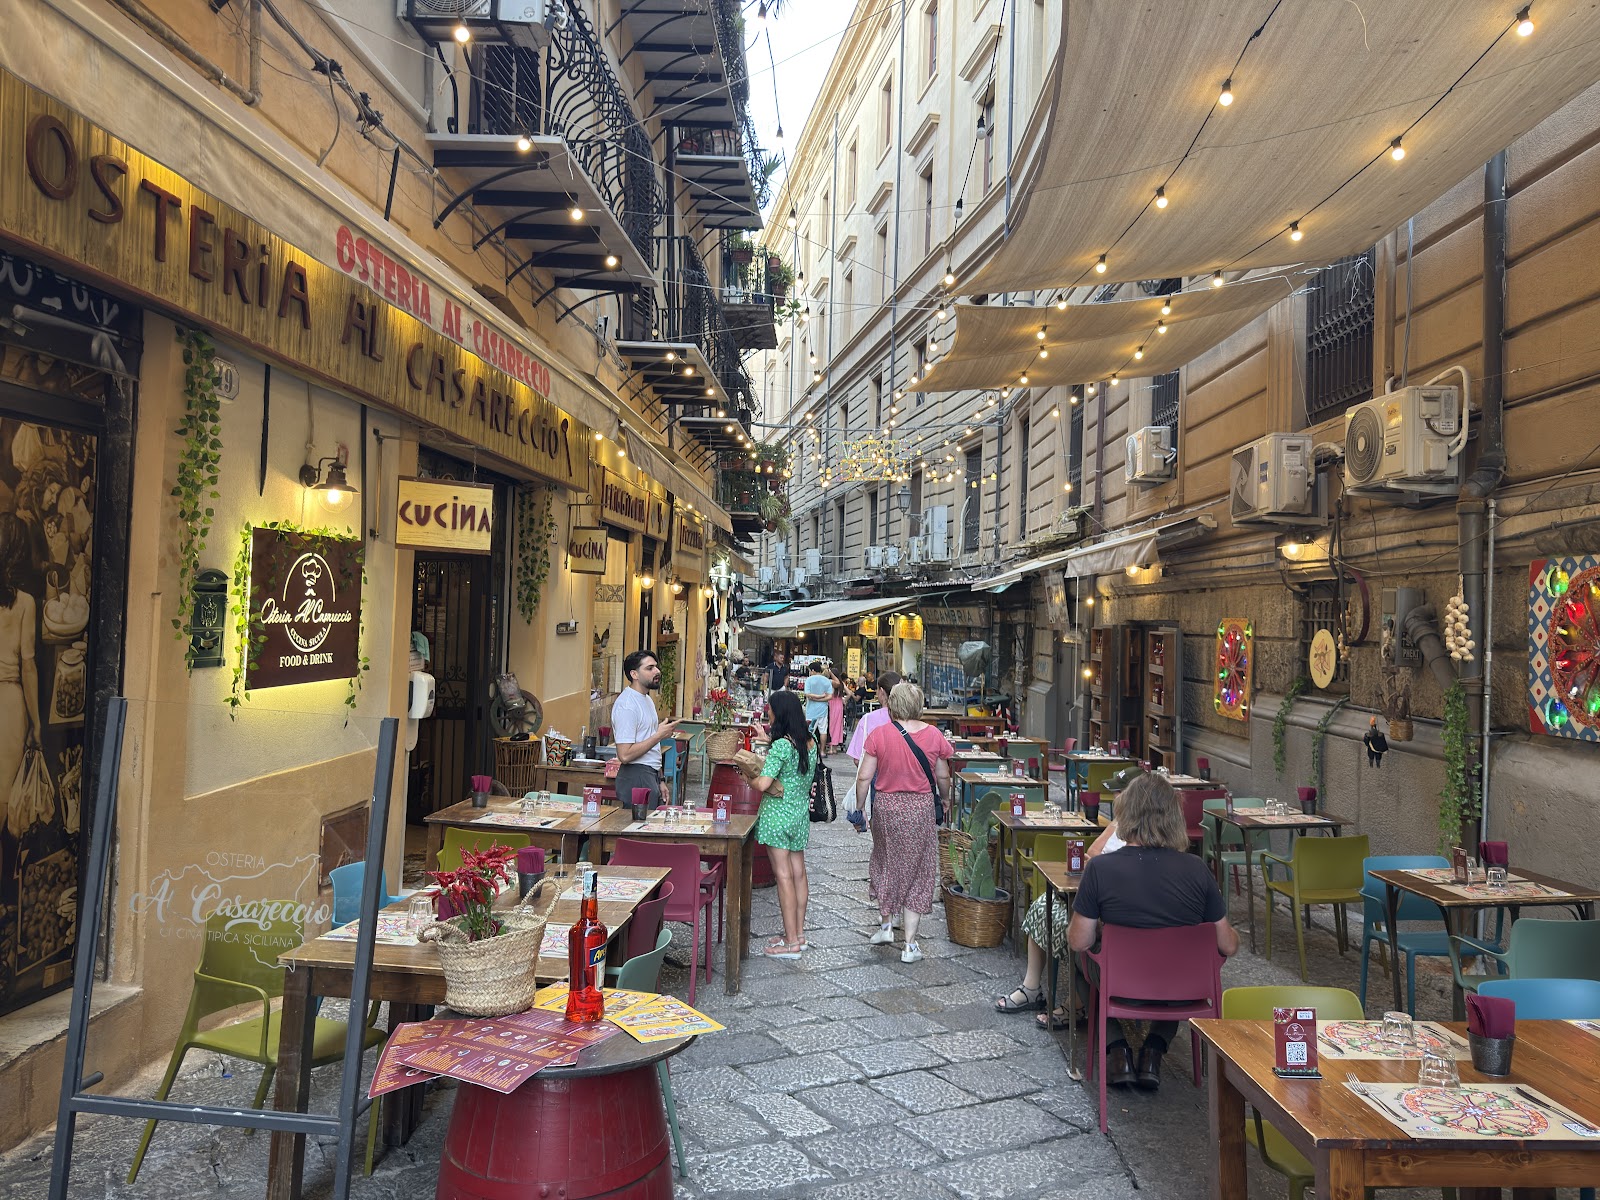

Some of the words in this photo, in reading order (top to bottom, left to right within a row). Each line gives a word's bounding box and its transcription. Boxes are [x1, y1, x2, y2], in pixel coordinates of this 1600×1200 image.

[341, 293, 385, 362] AL
[442, 298, 464, 344] AL
[473, 320, 550, 398] CASARECCIO
[260, 597, 293, 624] Osteria
[294, 598, 316, 624] Al
[290, 627, 308, 648] CUCINA
[279, 654, 302, 668] FOOD
[302, 654, 309, 666] &
[309, 652, 333, 665] DRINK
[206, 851, 266, 869] OSTERIA
[191, 883, 333, 932] Casareccio
[207, 930, 240, 944] TIPICA
[243, 933, 294, 949] SICILIANA
